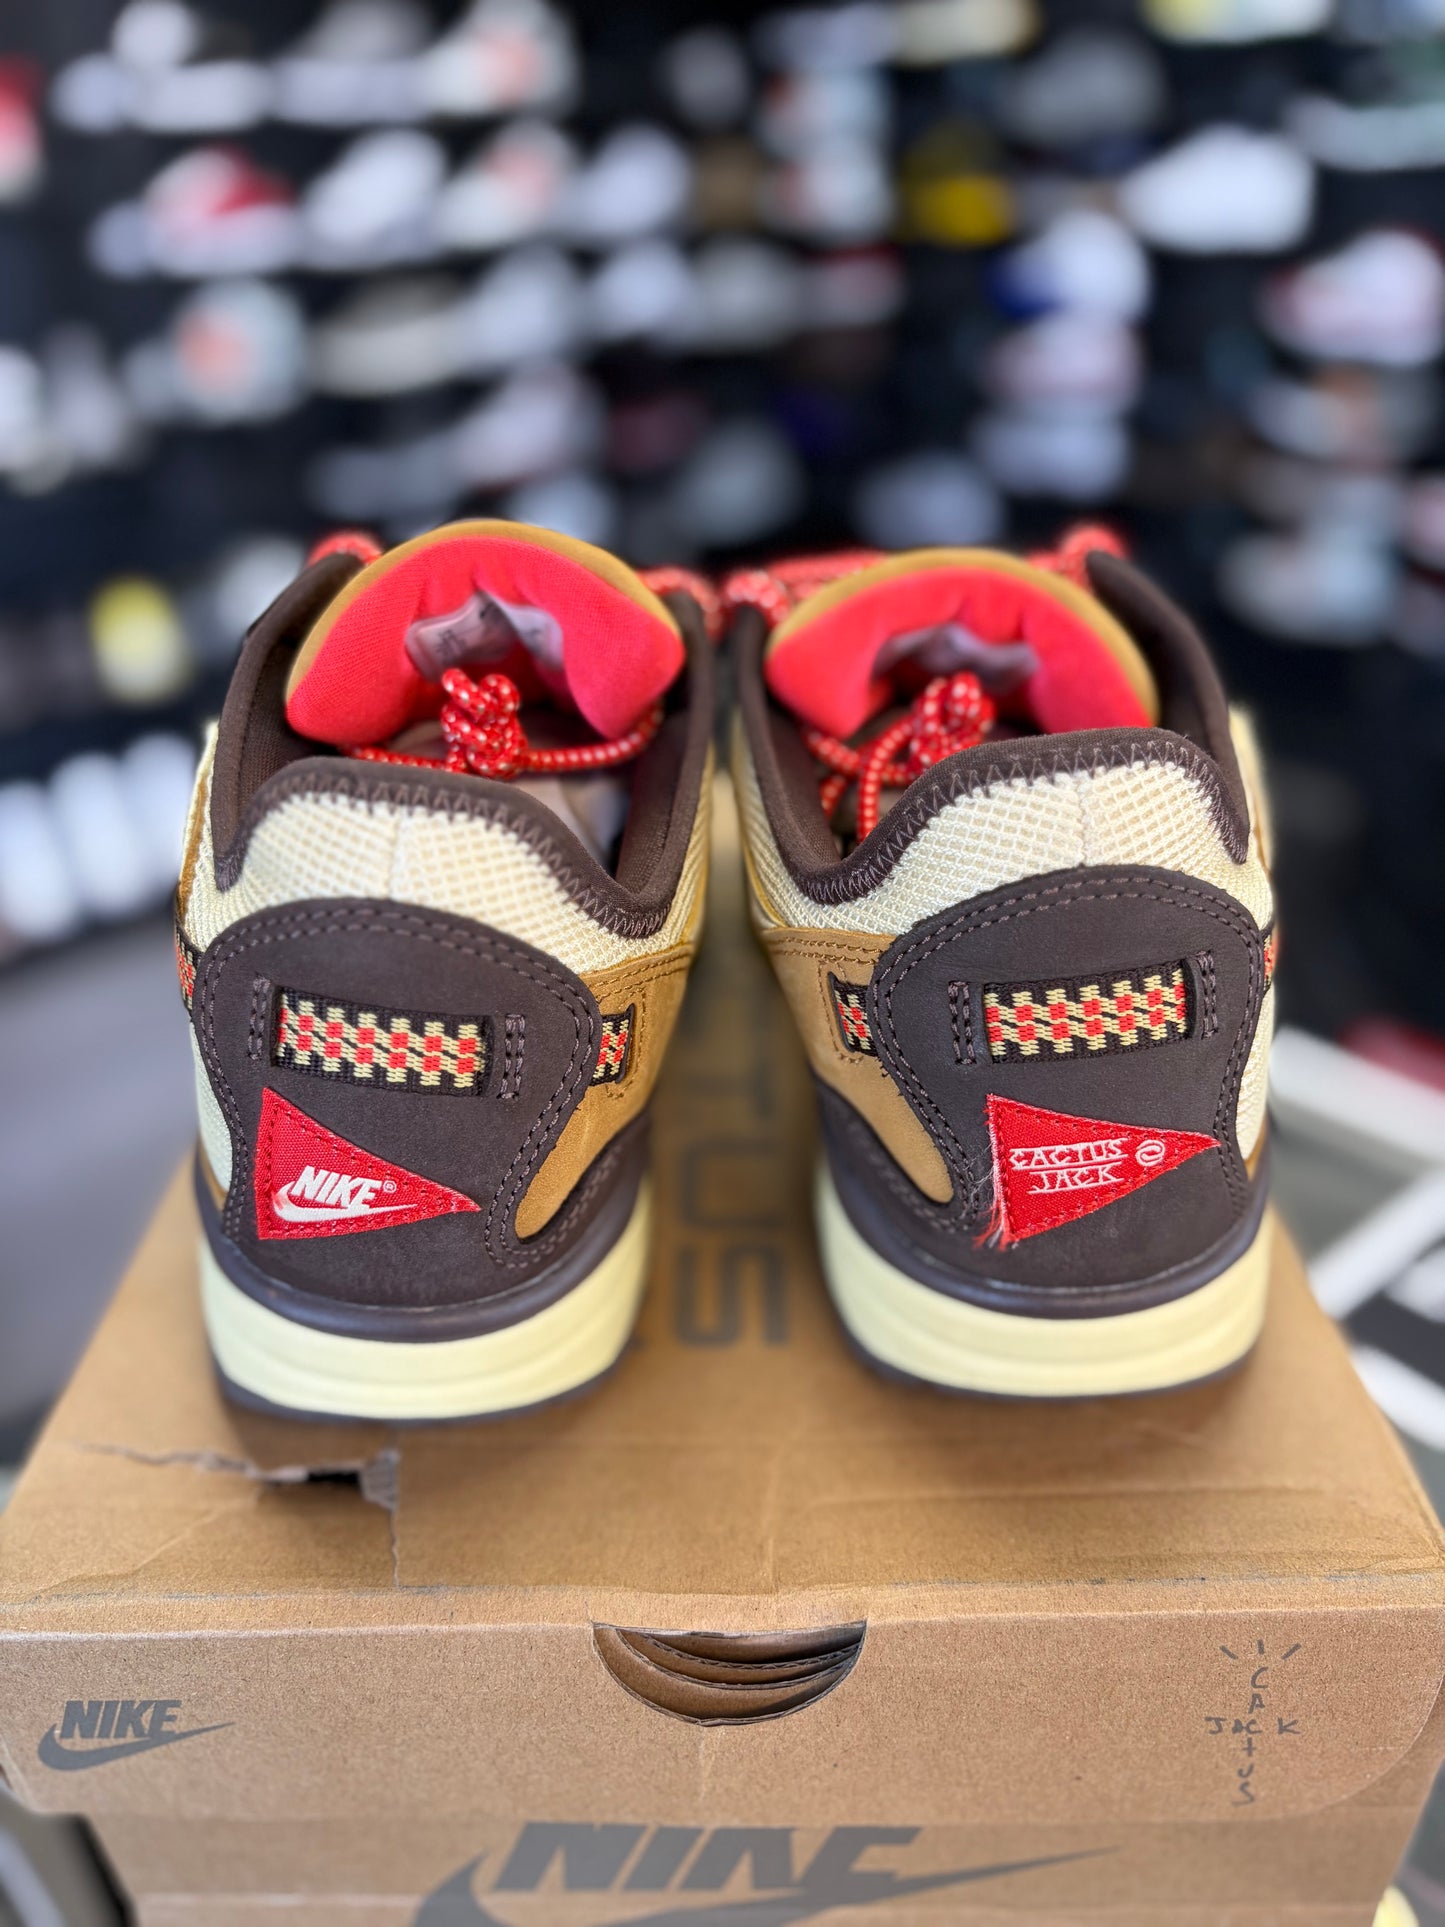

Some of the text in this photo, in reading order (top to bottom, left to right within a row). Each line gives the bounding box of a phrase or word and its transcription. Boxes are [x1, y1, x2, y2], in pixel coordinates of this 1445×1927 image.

[1009, 1137, 1129, 1171] CACTUS
[1028, 1161, 1125, 1195] JACK
[60, 1699, 182, 1739] NIKE
